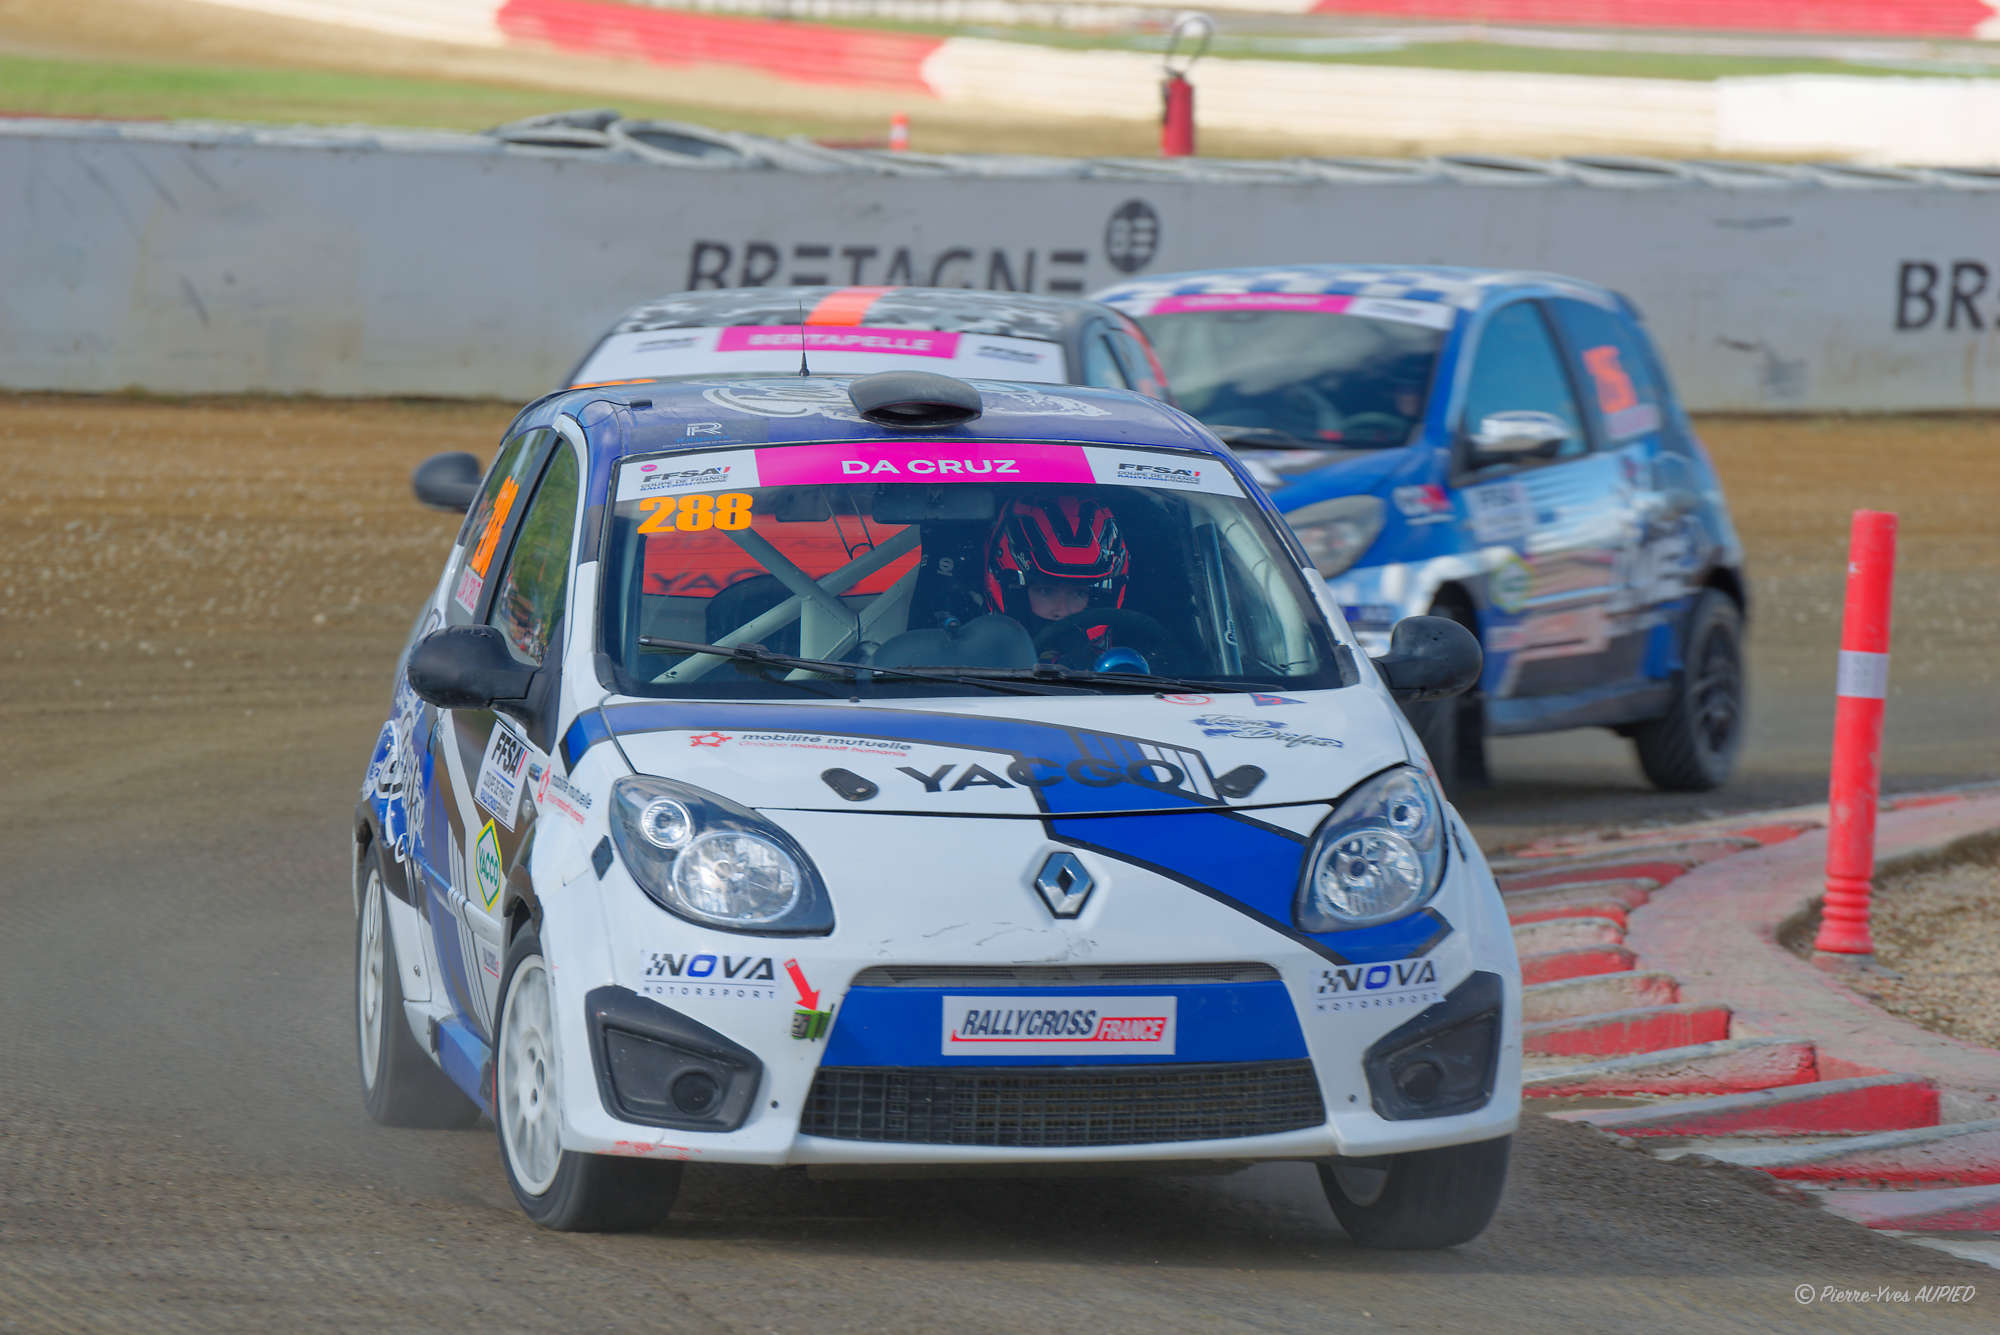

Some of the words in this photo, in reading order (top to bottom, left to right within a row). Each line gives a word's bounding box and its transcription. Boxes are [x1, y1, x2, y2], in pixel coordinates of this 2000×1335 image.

[1896, 259, 2000, 331] BR
[748, 330, 933, 352] BERTAPELLE
[841, 460, 900, 475] DA
[907, 459, 1020, 475] CRUZ
[637, 493, 753, 534] 288
[741, 733, 822, 743] mobilité
[646, 953, 776, 981] NOVA
[1317, 959, 1437, 993] NOVA
[643, 986, 776, 999] MOTORSPORT
[962, 1009, 1097, 1036] RALLYCROSS
[1098, 1019, 1165, 1040] FRANCE
